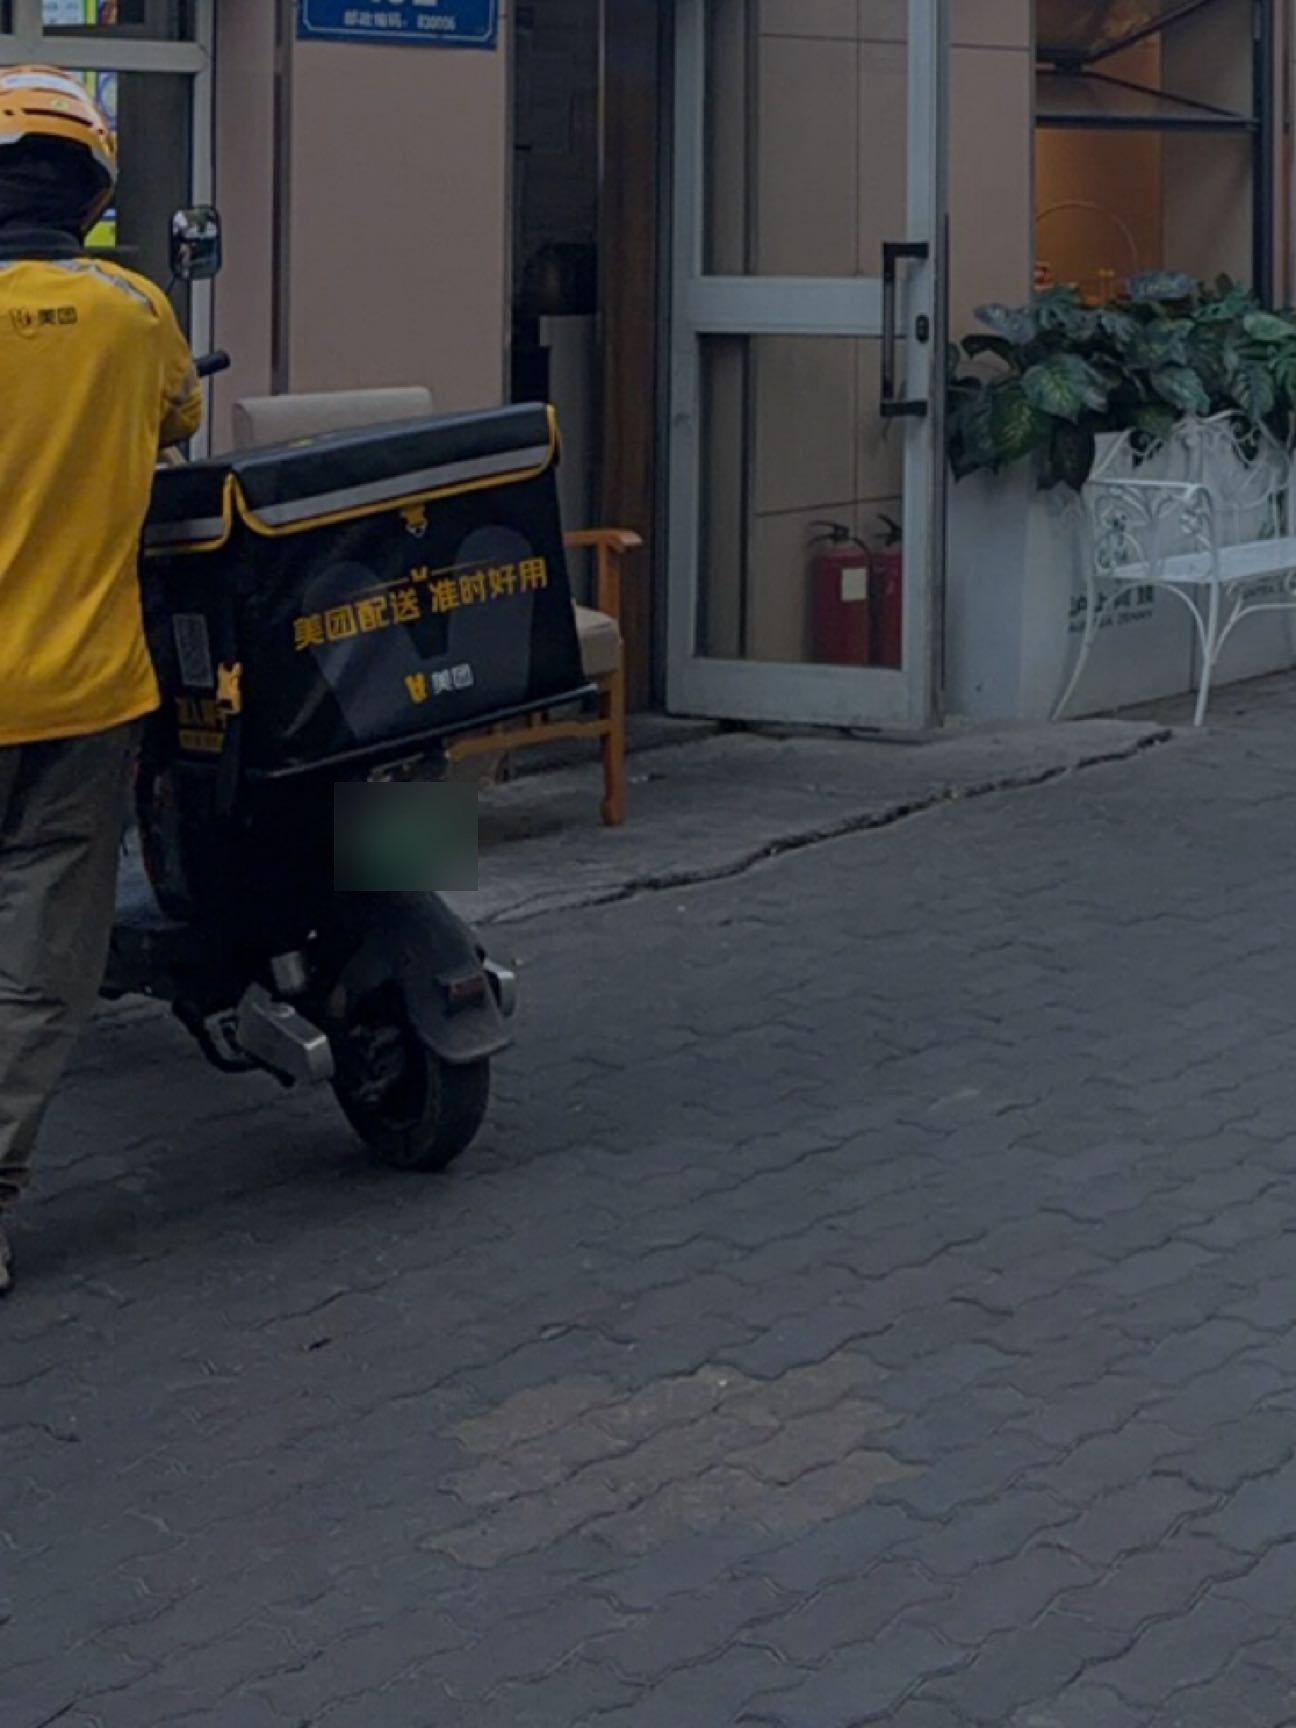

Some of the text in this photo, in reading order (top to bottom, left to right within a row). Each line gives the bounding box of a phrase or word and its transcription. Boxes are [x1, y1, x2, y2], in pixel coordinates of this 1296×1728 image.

[292, 555, 549, 652] 美团配送 准时好用
